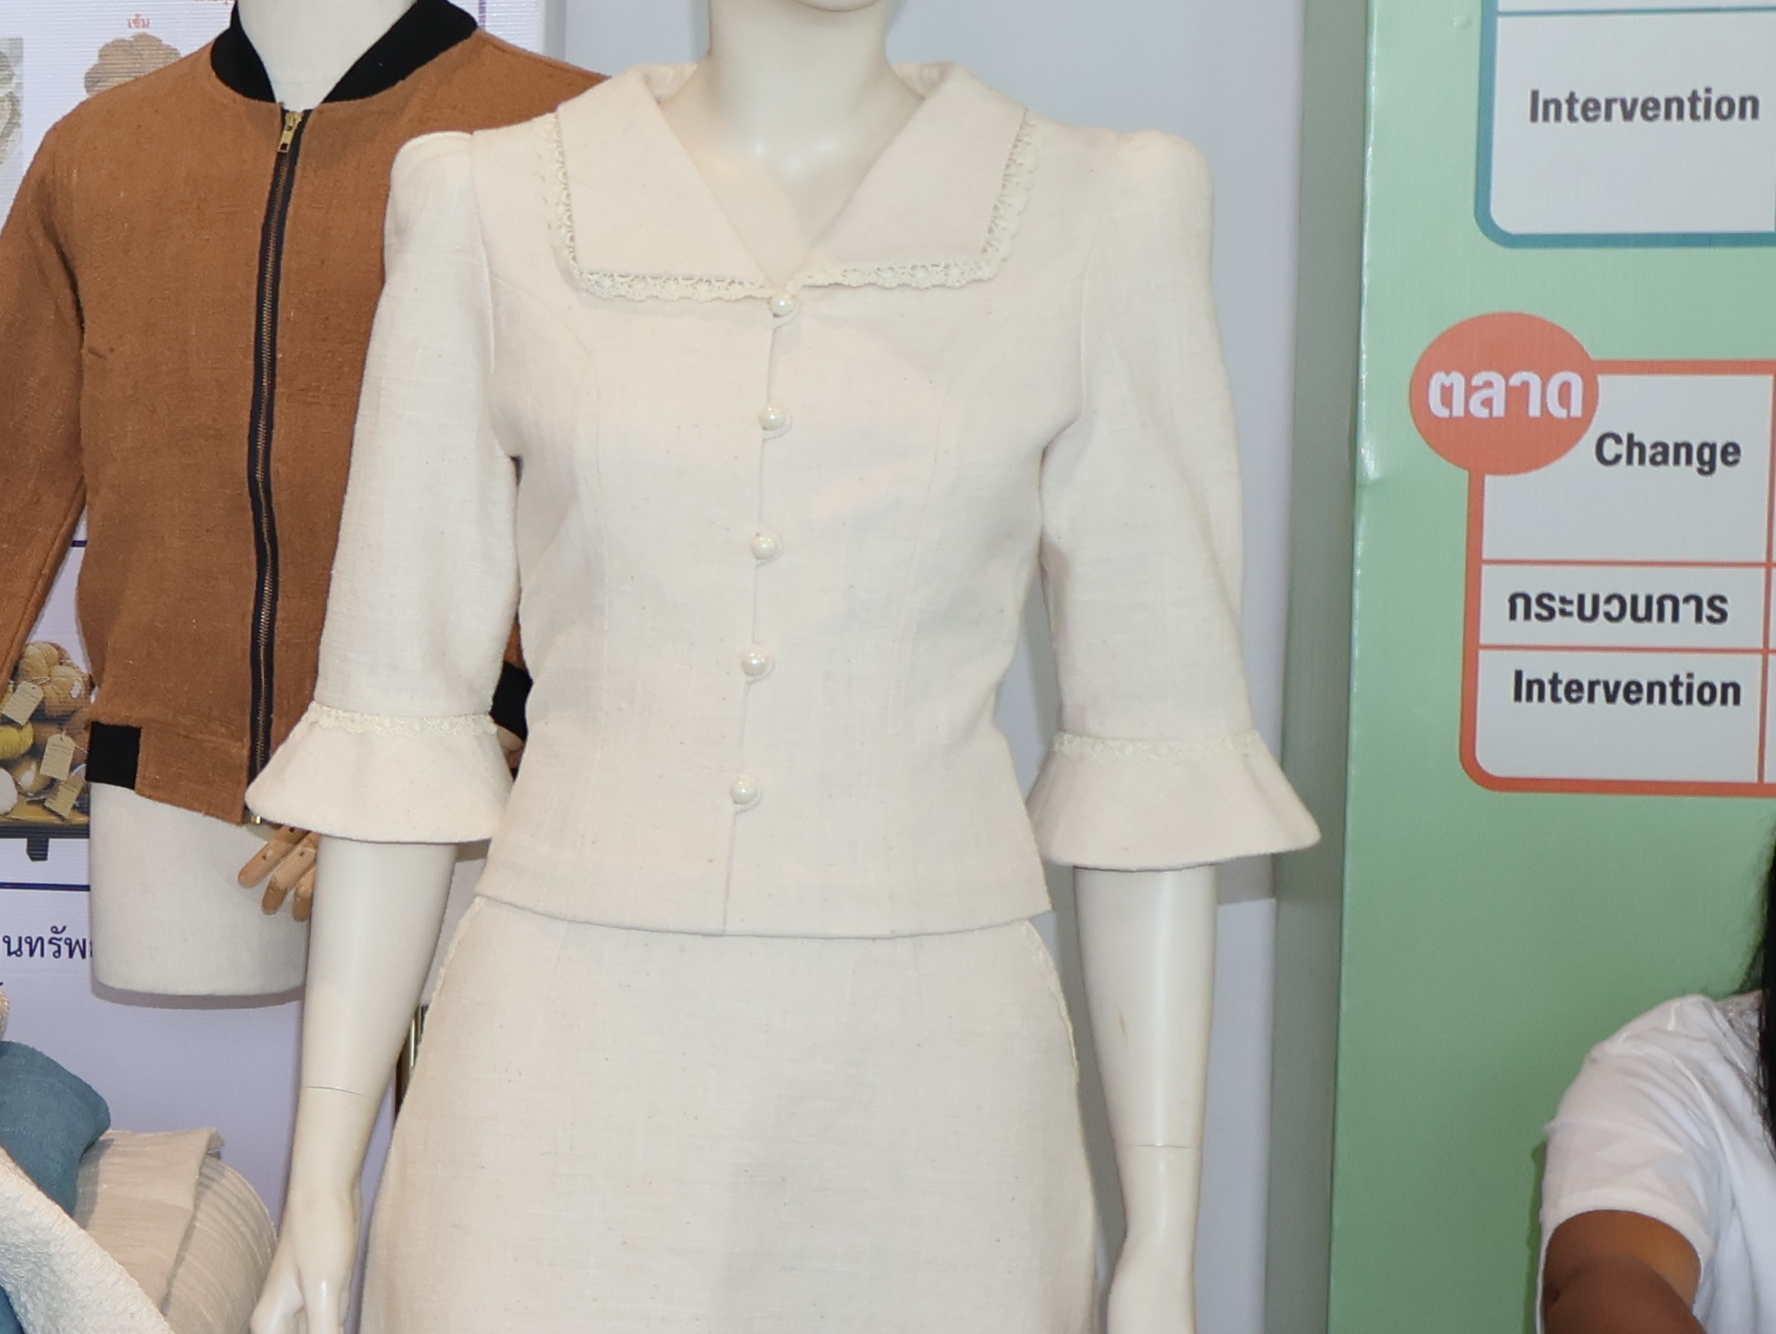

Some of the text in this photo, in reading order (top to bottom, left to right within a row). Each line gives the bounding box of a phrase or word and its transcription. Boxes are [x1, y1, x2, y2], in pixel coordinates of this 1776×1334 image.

[1529, 87, 1760, 123] Intervention
[1427, 370, 1584, 419] ตลาด
[1594, 431, 1742, 476] Change
[1508, 591, 1729, 625] กระบวนการ
[1513, 669, 1742, 707] Intervention
